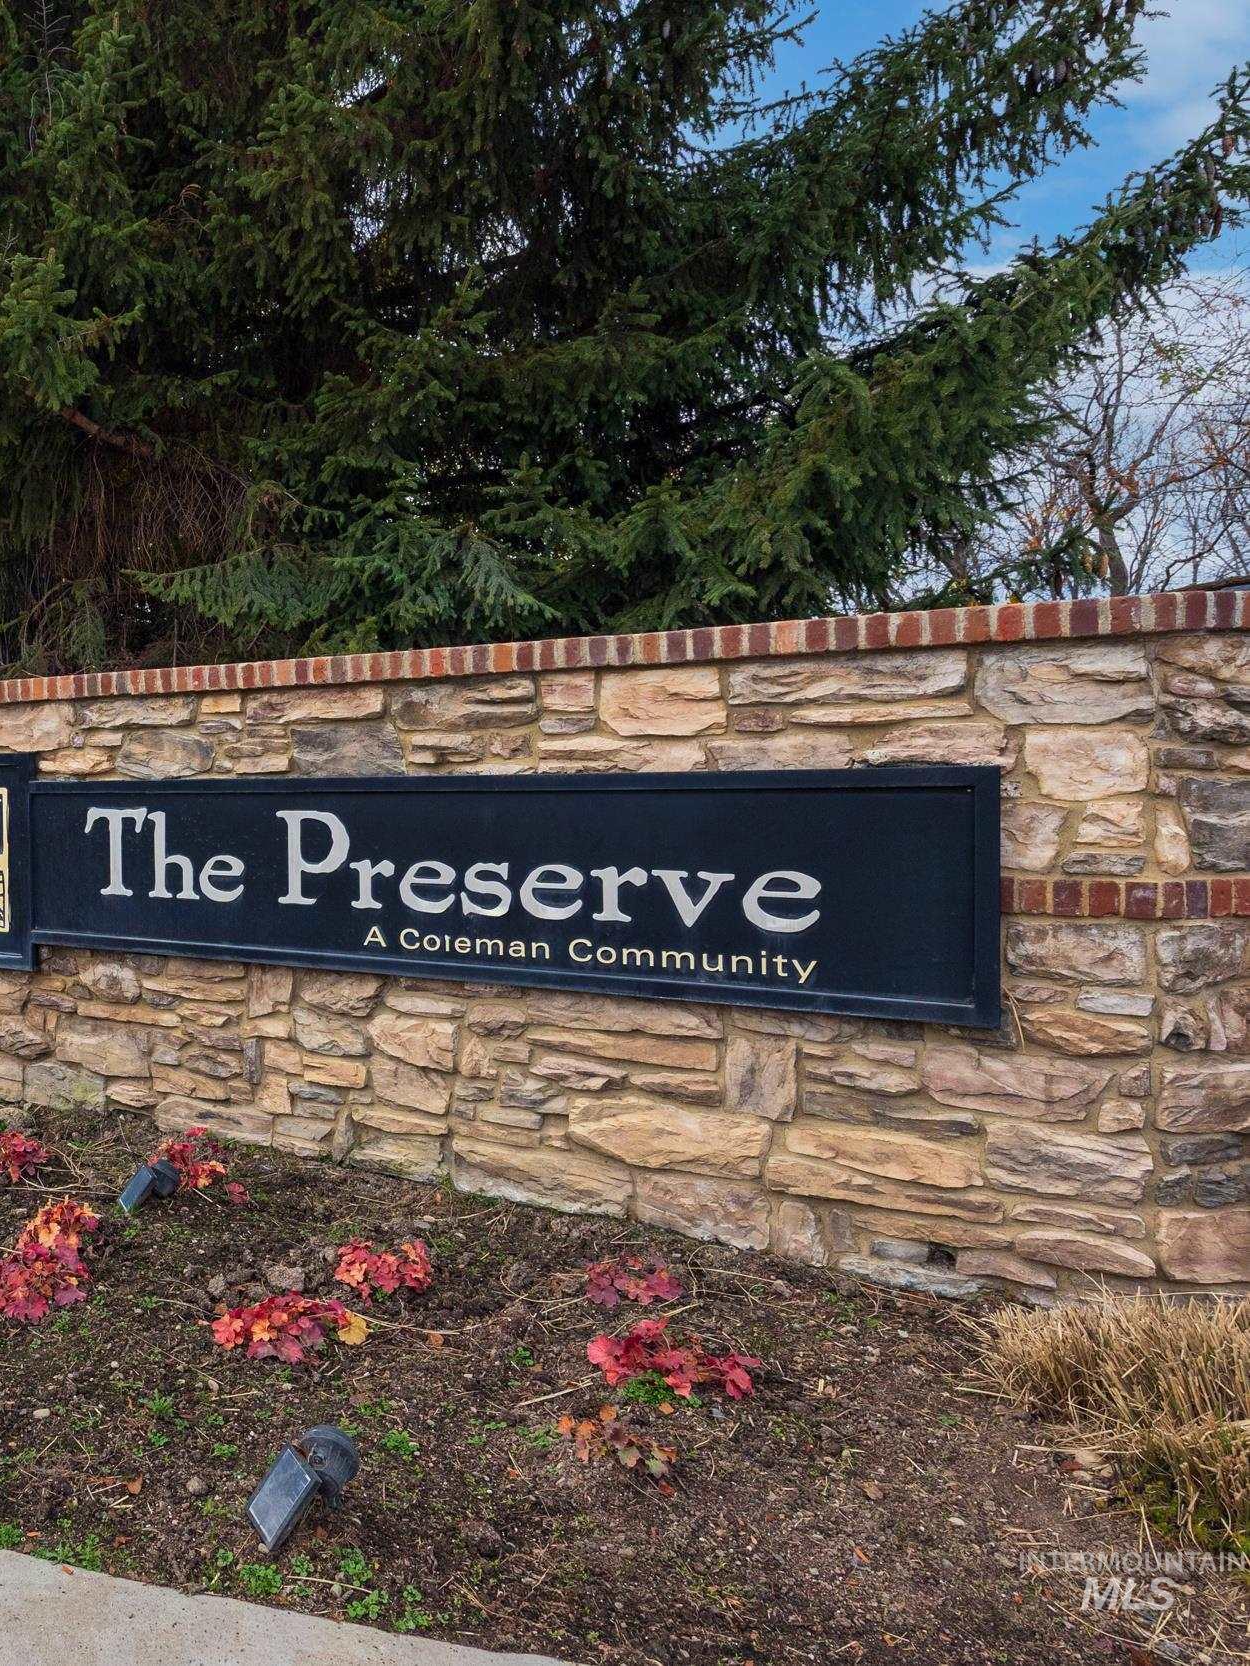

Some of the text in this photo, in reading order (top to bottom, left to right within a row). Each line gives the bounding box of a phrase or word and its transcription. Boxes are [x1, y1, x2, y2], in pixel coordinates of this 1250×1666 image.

[84, 806, 822, 933] The Preserve
[363, 926, 387, 948] A
[568, 938, 818, 984] Community
